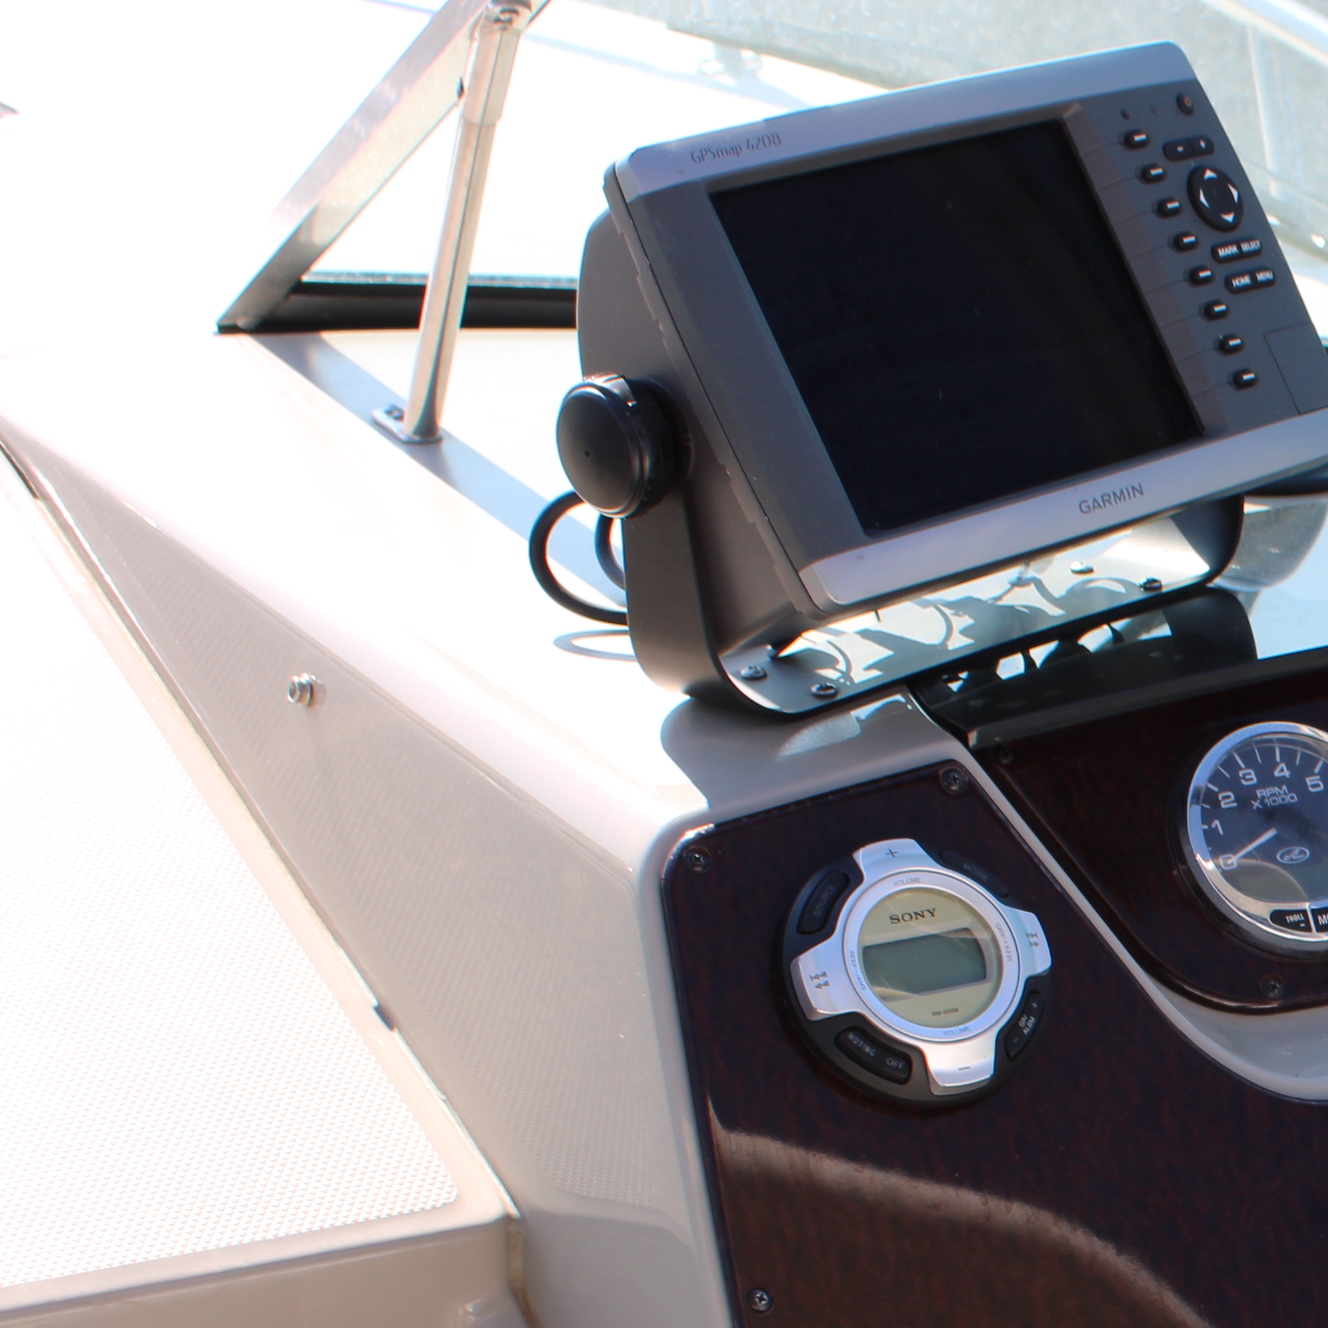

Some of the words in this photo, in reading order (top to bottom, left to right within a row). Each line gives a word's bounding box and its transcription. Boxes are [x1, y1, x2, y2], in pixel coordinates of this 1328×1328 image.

[691, 144, 742, 163] GPSmap
[1217, 242, 1239, 258] MARK
[1241, 238, 1260, 252] SELECT
[1232, 274, 1252, 288] HOME
[1078, 482, 1144, 515] GARMIN
[1239, 769, 1257, 785] 3
[1274, 763, 1290, 778] 4
[1256, 785, 1289, 798] RPM
[1305, 775, 1324, 792] 5
[1218, 791, 1238, 809] 2
[1211, 819, 1224, 835] 1
[1220, 854, 1238, 870] 0
[892, 877, 922, 887] VOLUME
[889, 908, 937, 924] SONY
[1286, 914, 1305, 923] TROLL
[943, 1026, 971, 1036] VOLUME
[849, 1033, 876, 1057] MUTING
[886, 1057, 904, 1069] OFF
